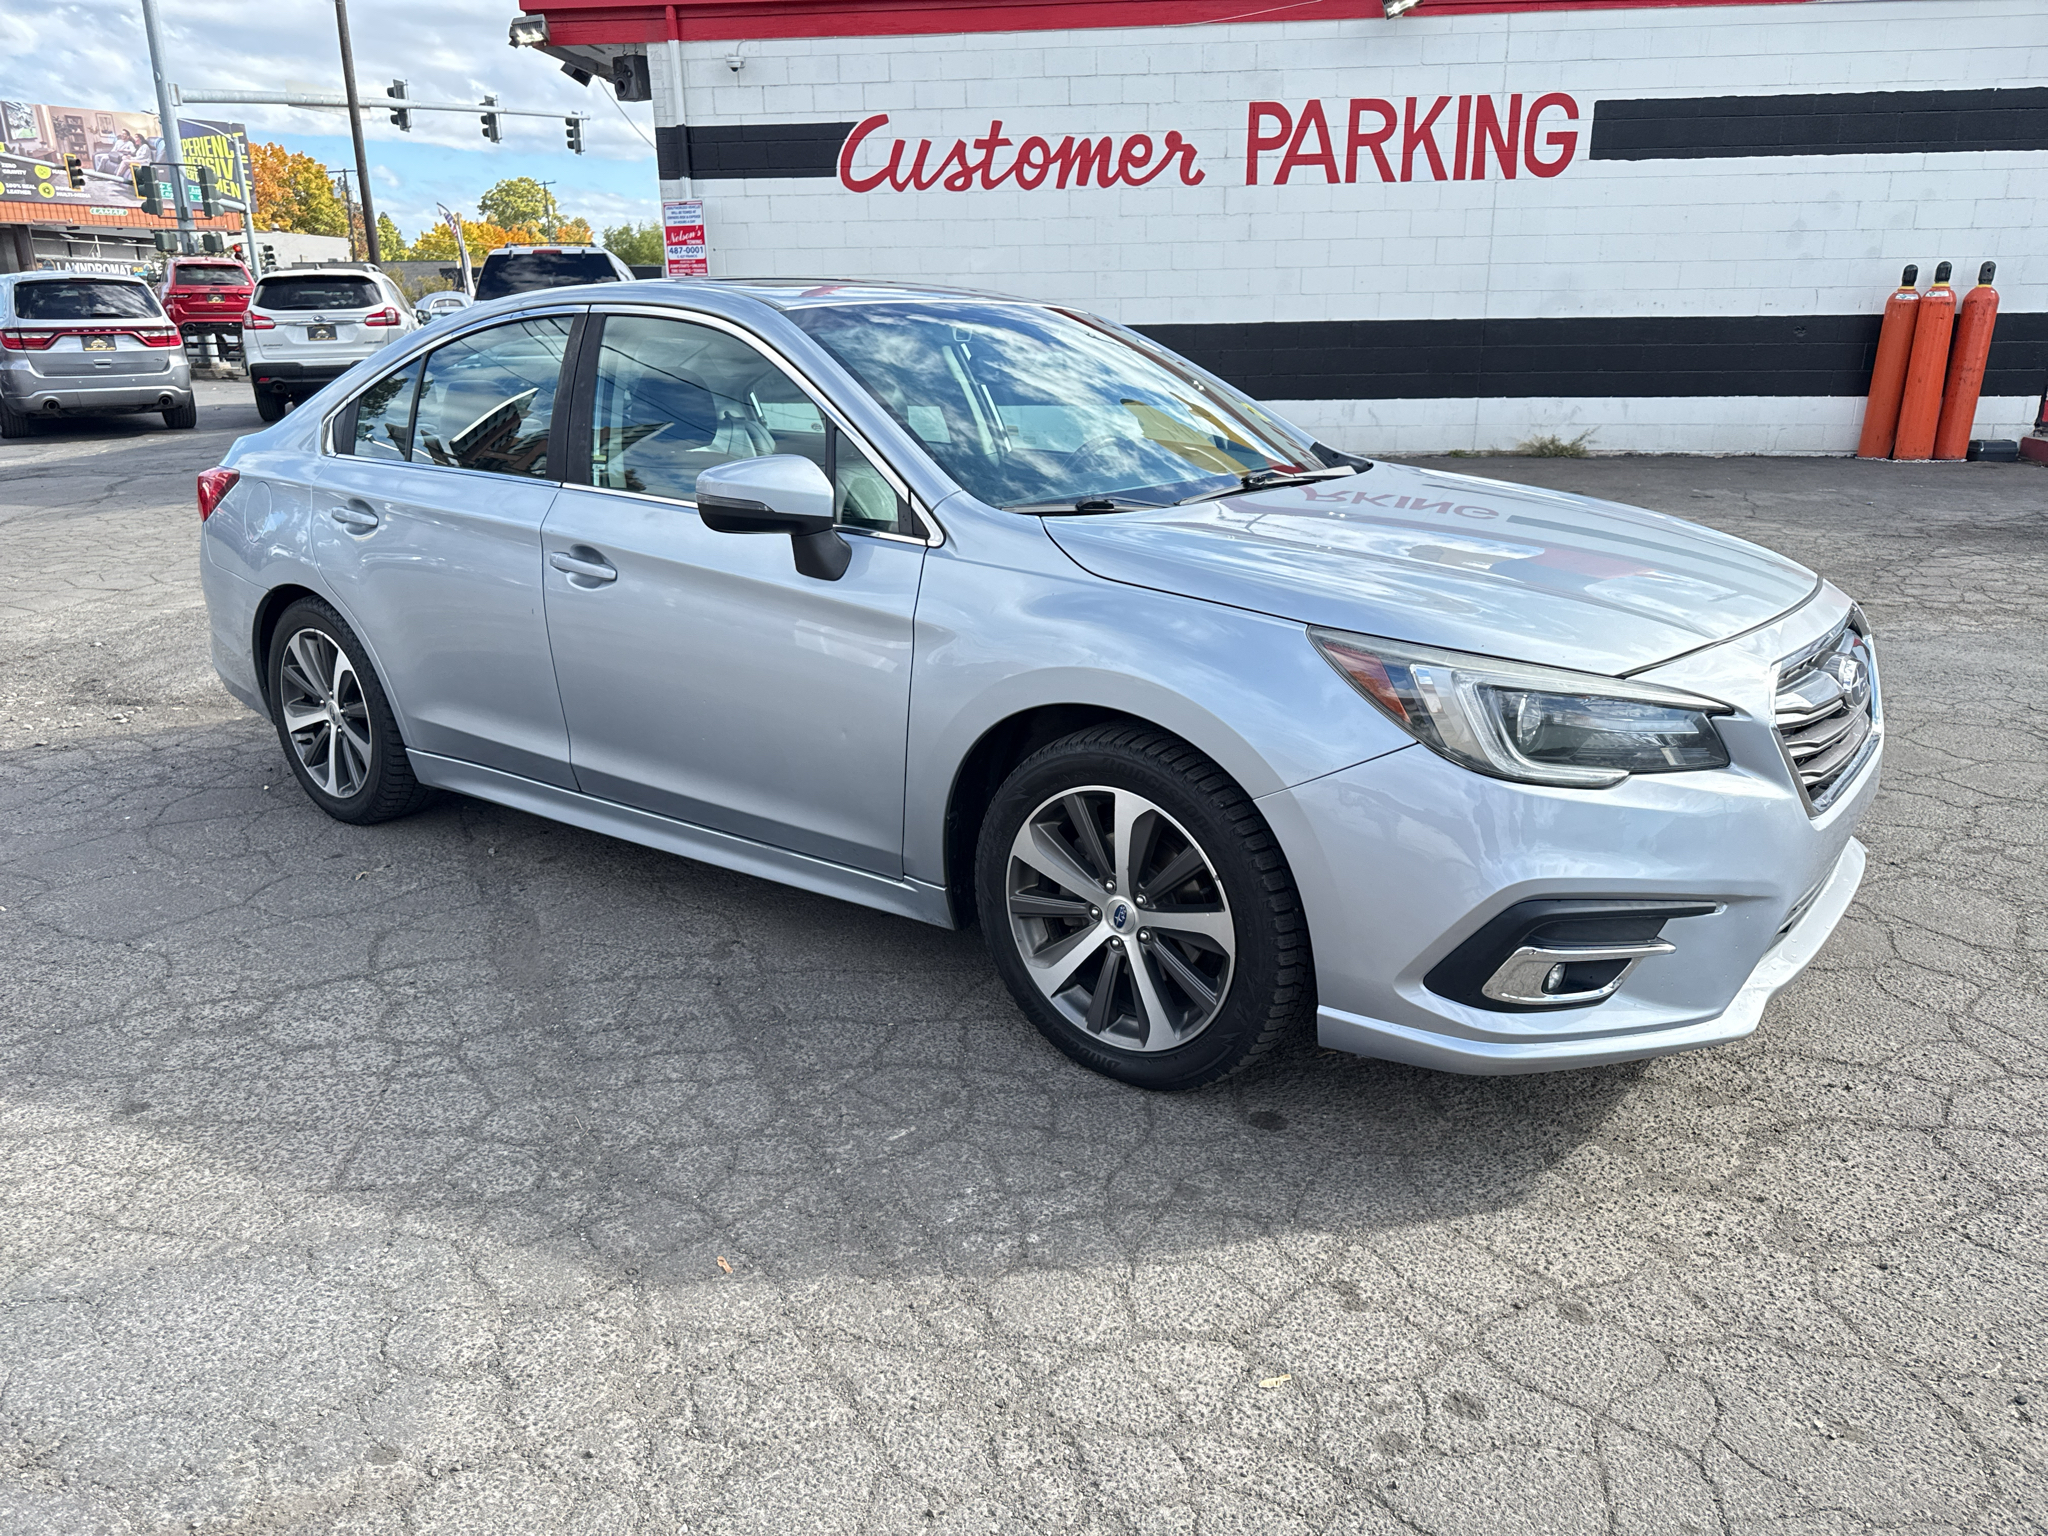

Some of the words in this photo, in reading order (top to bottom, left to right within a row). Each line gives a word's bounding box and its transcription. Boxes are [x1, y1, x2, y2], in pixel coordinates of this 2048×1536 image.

[840, 114, 1206, 193] Customer
[1246, 92, 1580, 185] PARKING
[667, 225, 703, 245] Nelson's
[669, 246, 704, 255] 487-0001
